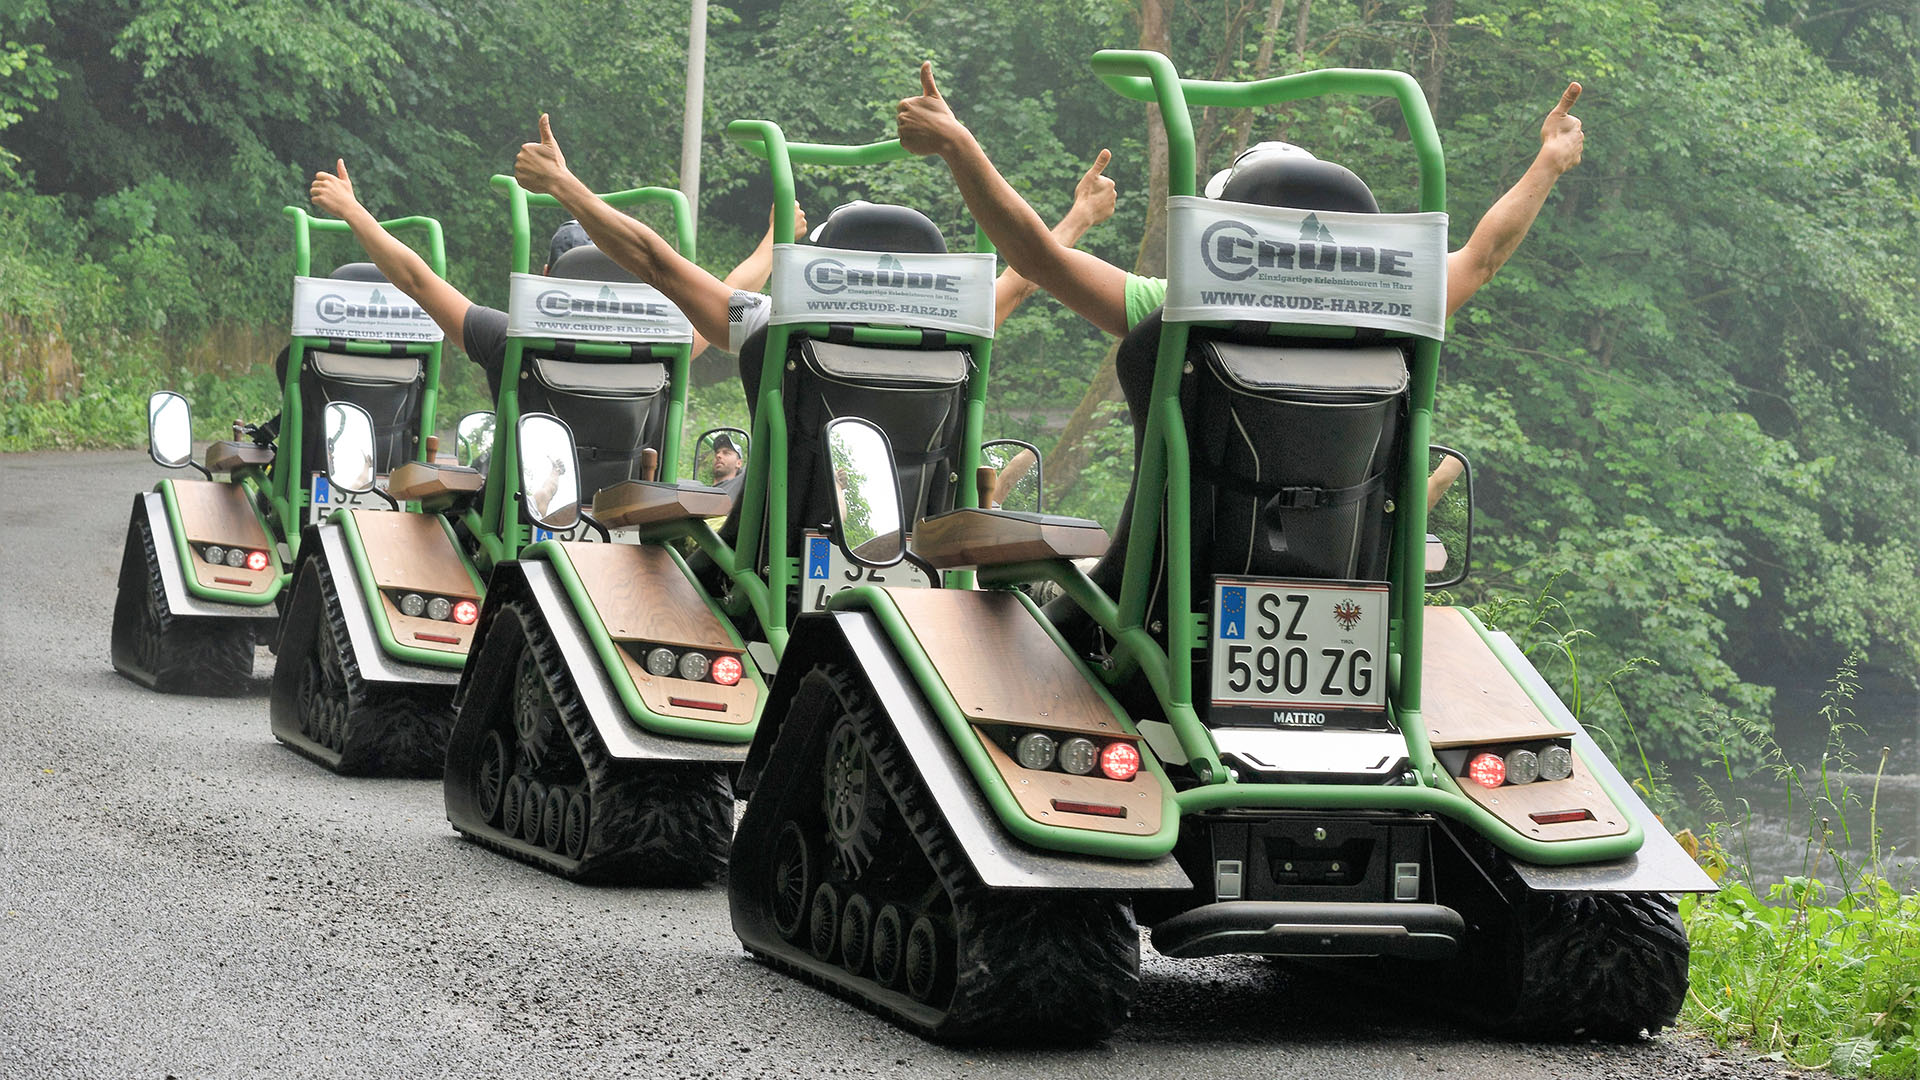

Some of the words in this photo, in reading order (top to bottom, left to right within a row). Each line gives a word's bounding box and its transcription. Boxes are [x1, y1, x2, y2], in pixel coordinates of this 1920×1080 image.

[1201, 220, 1414, 282] CRUDE
[804, 258, 961, 295] CRUDE
[1258, 273, 1313, 284] Einzigartige
[1314, 276, 1378, 288] Erlebnistouren
[1392, 282, 1413, 291] Harz
[536, 290, 668, 318] CRUDE
[807, 300, 958, 319] WWW.CRUDE-HARZ.DE
[1200, 291, 1412, 317] WWW.CRUDE-HARZ.DE
[315, 328, 432, 341] WWW.CRUDE-HARZ.DE
[535, 321, 670, 335] WWW.CRUDE-HARZ.DE
[540, 531, 549, 540] A
[814, 565, 824, 577] A
[1257, 593, 1310, 641] SZ
[1226, 621, 1238, 636] A
[1228, 645, 1308, 694] 590
[1320, 649, 1372, 696] ZG
[1273, 711, 1326, 724] MATTRO
